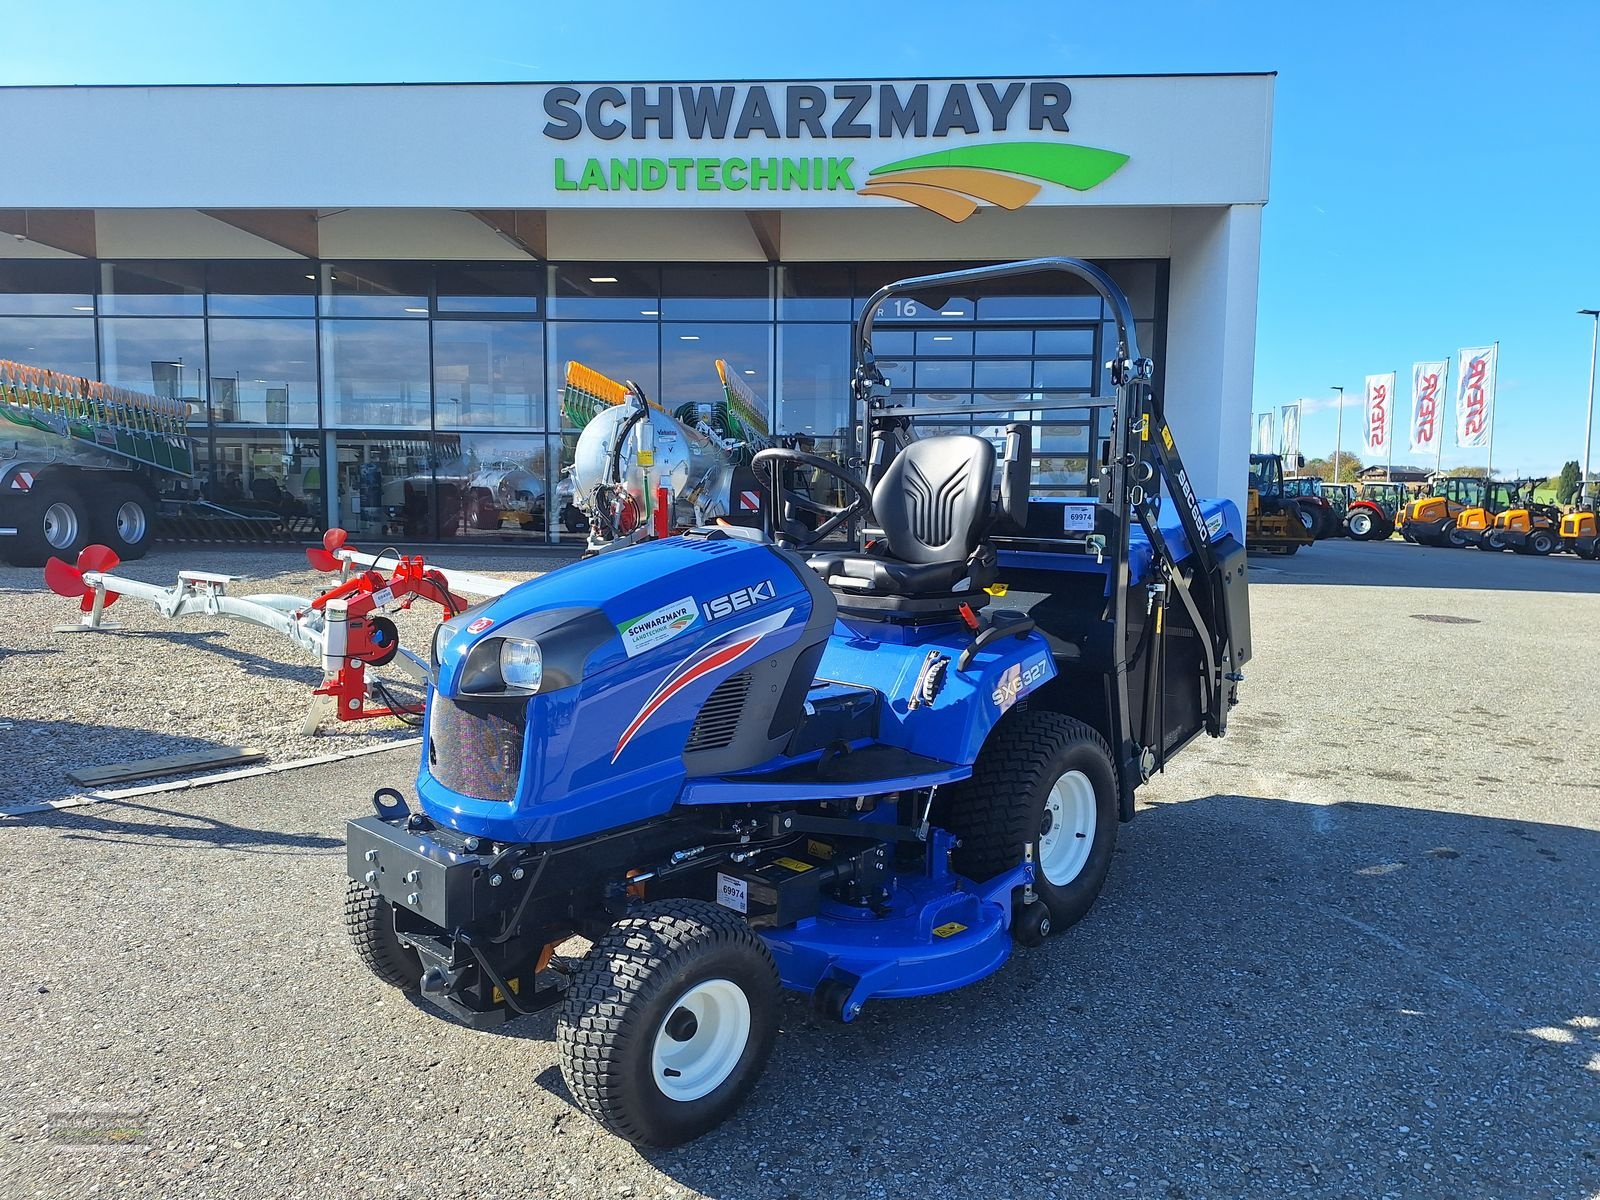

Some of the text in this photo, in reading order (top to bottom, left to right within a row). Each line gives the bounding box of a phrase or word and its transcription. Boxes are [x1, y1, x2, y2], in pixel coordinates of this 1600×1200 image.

[542, 82, 1072, 140] SCHWARZMAYR
[555, 156, 855, 192] LANDTECHNIK
[894, 300, 917, 317] 16
[1070, 513, 1092, 521] 69974
[702, 580, 776, 621] ISEKI
[628, 607, 688, 637] SCHWARZMAYR
[632, 625, 668, 643] LANDTECHNIK
[991, 659, 1047, 706] SXG327
[723, 885, 744, 899] 69974
